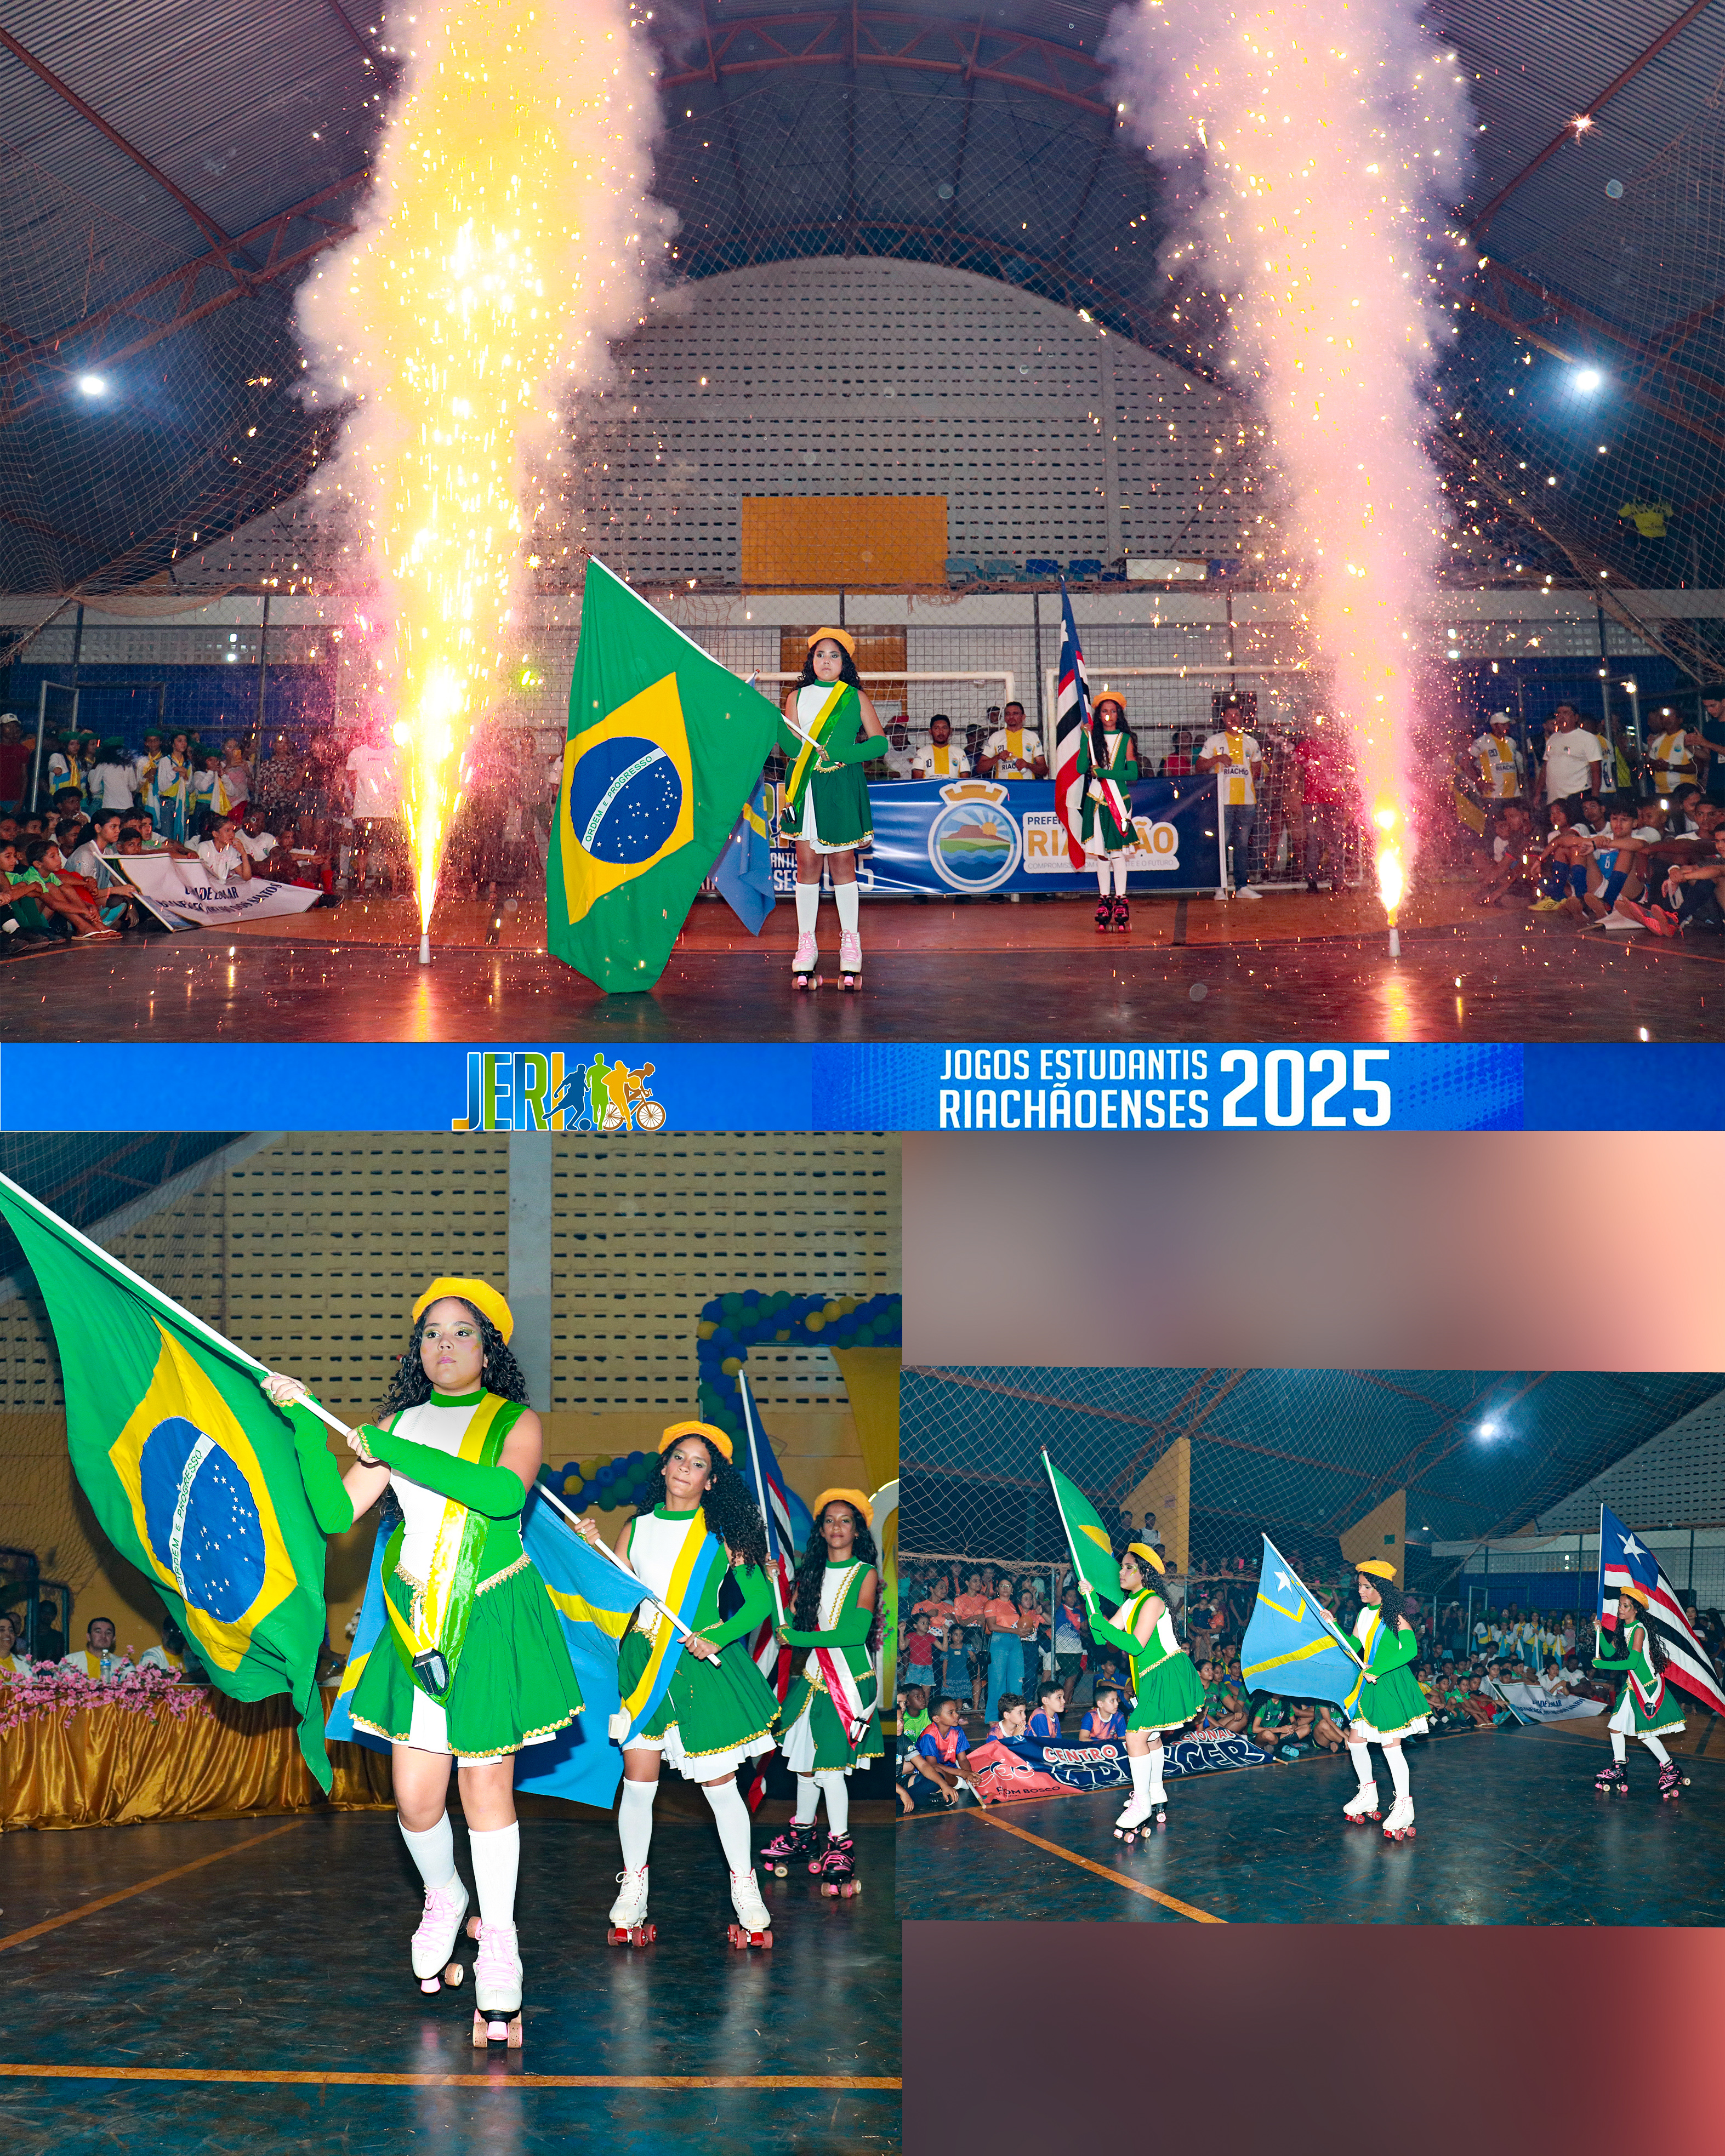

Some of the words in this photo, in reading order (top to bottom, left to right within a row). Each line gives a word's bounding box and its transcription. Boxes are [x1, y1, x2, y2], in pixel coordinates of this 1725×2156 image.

[585, 810, 604, 842] ORDEM
[608, 756, 652, 798] PROGRESSO
[247, 883, 282, 904] SANTOS
[172, 1538, 183, 1585] ORDEM
[178, 1450, 202, 1518] PROGRESSO
[1043, 1744, 1118, 1763] CENTRO
